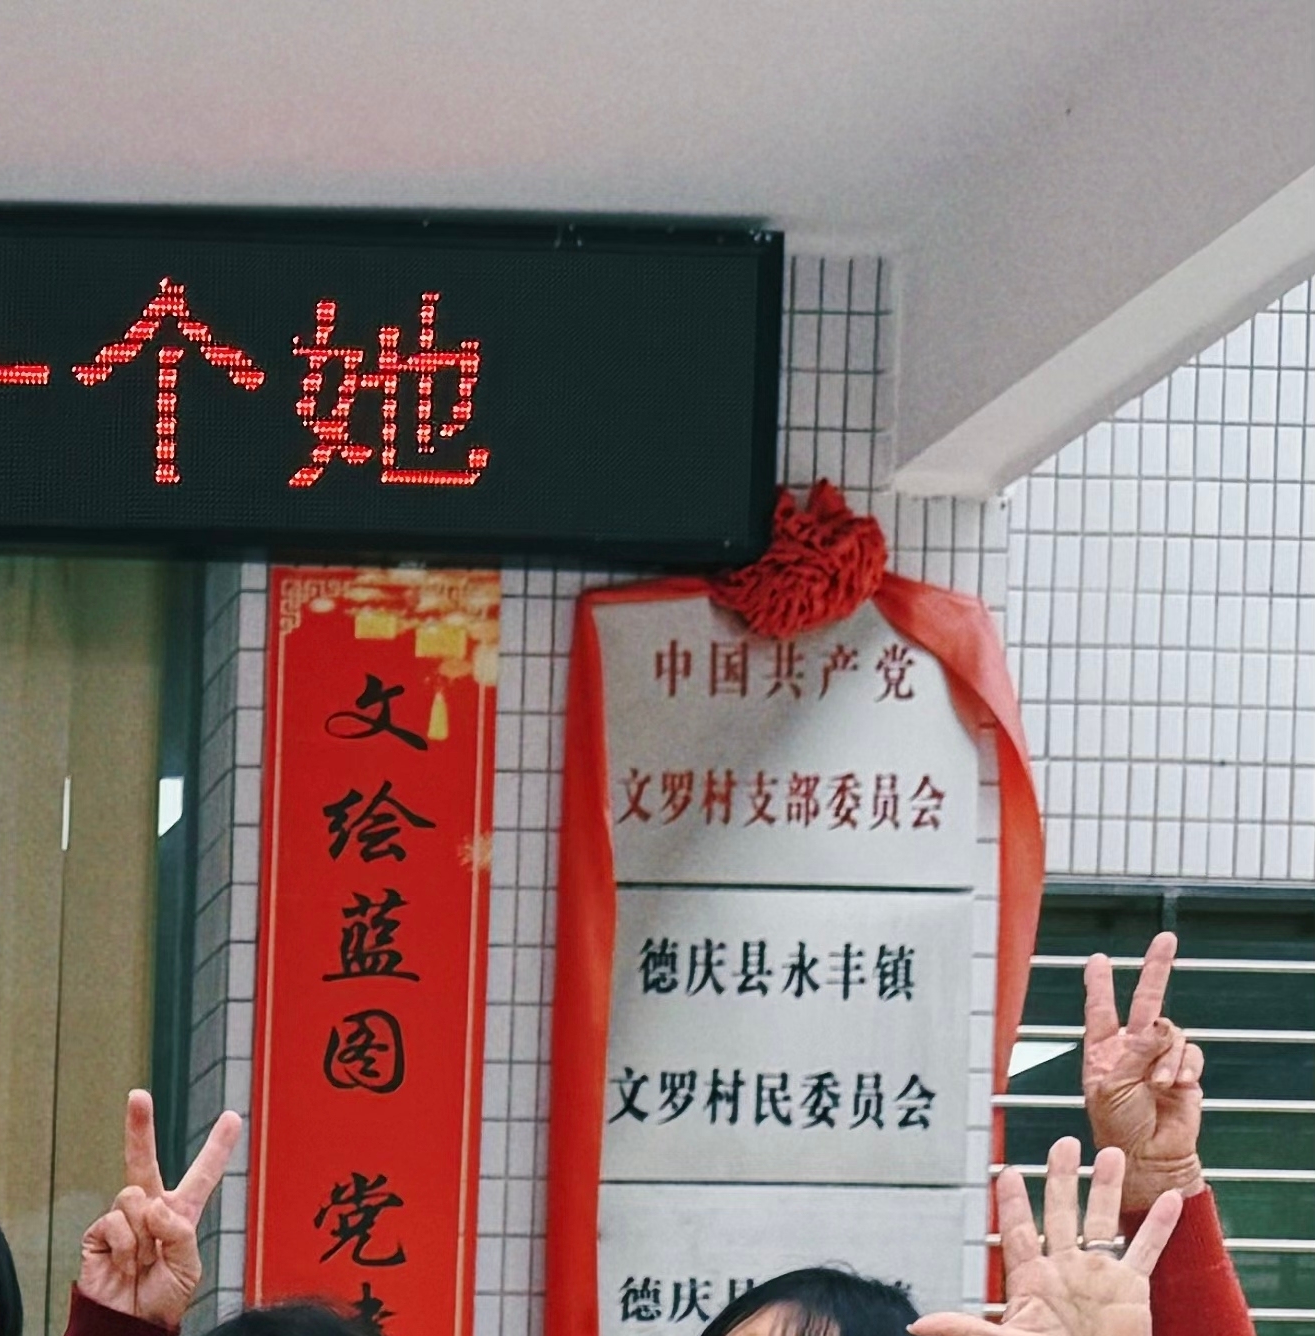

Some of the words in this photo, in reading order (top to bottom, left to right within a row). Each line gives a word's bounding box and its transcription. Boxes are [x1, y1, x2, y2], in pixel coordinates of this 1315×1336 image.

[654, 639, 917, 702] 中国共产党
[617, 767, 947, 832] 文罗村支部委员会
[638, 936, 917, 1002] 德庆县永丰镇
[607, 1065, 937, 1130] 文罗村民委员会
